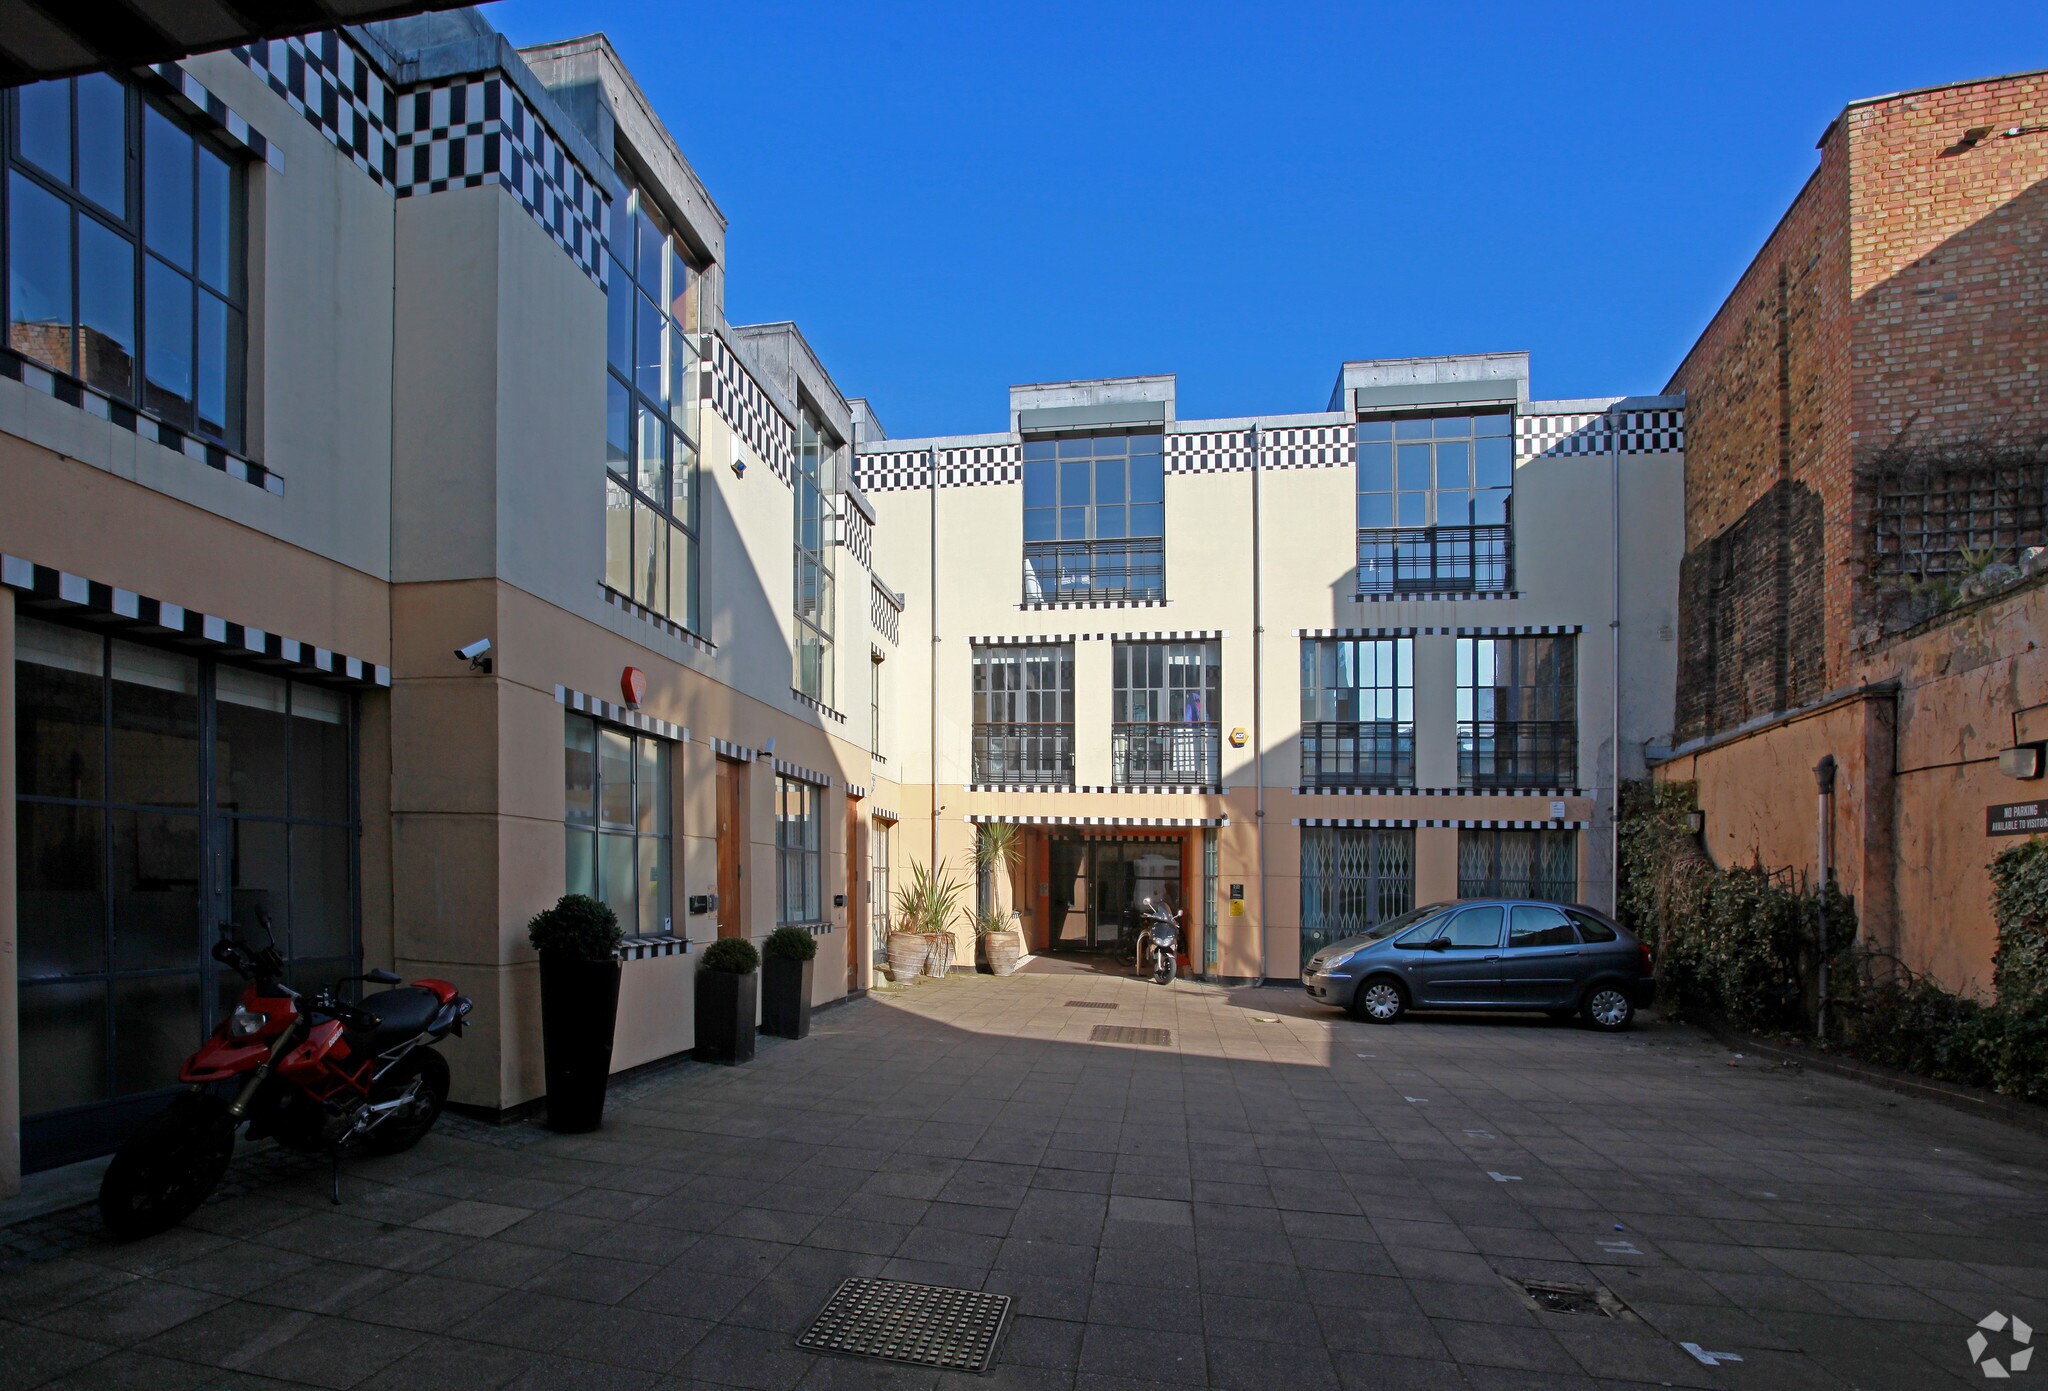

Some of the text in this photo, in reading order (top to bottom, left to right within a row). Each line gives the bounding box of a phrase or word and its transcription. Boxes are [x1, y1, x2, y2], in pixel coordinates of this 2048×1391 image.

[2004, 804, 2038, 818] NO PARKING
[1992, 820, 2018, 831] AVAILABLE
[2019, 819, 2026, 829] TO
